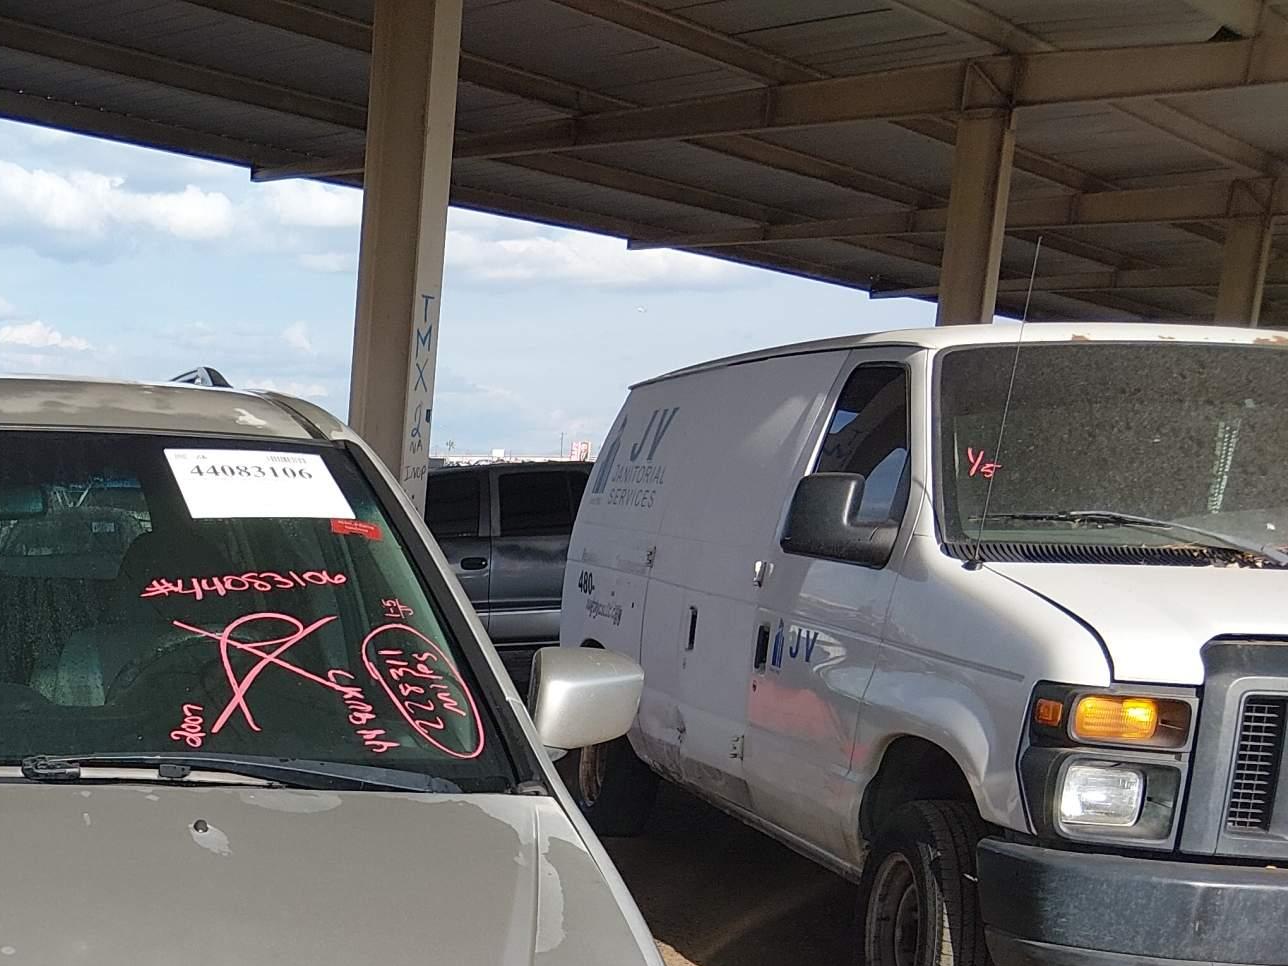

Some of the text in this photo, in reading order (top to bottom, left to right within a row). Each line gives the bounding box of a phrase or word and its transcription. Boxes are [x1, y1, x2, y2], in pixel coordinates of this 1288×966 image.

[629, 407, 680, 461] JV
[190, 464, 313, 480] 44083106
[610, 463, 665, 485] JANITORIAL
[607, 489, 657, 509] SERVICES
[789, 628, 819, 663] JV
